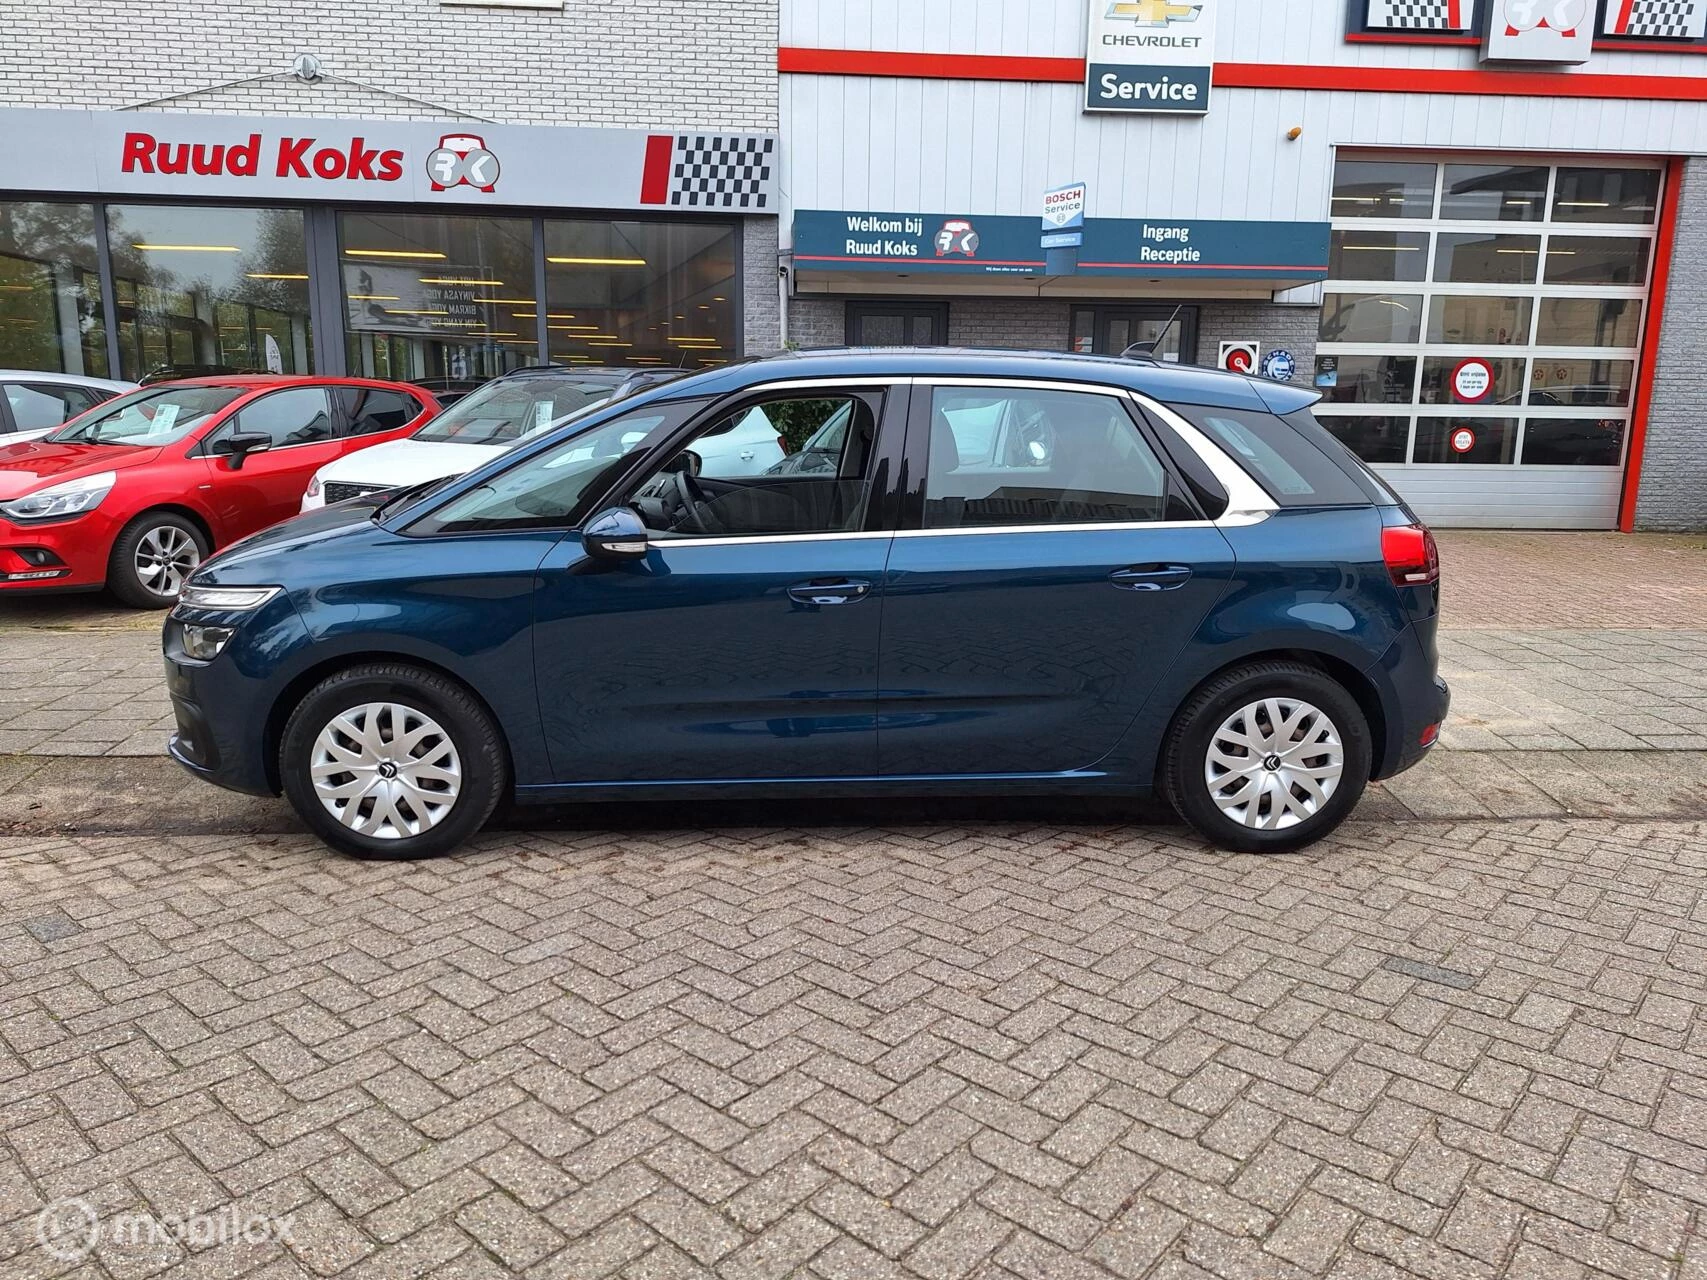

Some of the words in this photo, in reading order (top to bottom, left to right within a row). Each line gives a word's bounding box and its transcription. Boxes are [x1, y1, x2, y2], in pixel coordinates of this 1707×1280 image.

[1102, 34, 1202, 48] CHEVROLET
[1100, 73, 1198, 101] Service
[121, 132, 262, 176] Ruud
[275, 137, 404, 182] Koks
[1045, 190, 1081, 205] BOSCH
[1045, 202, 1080, 214] Service
[846, 216, 902, 232] Welkom
[905, 217, 923, 236] bij
[1142, 223, 1190, 242] Ingang
[846, 239, 881, 255] Ruud
[884, 240, 918, 256] Koks
[1140, 246, 1201, 264] Receptie
